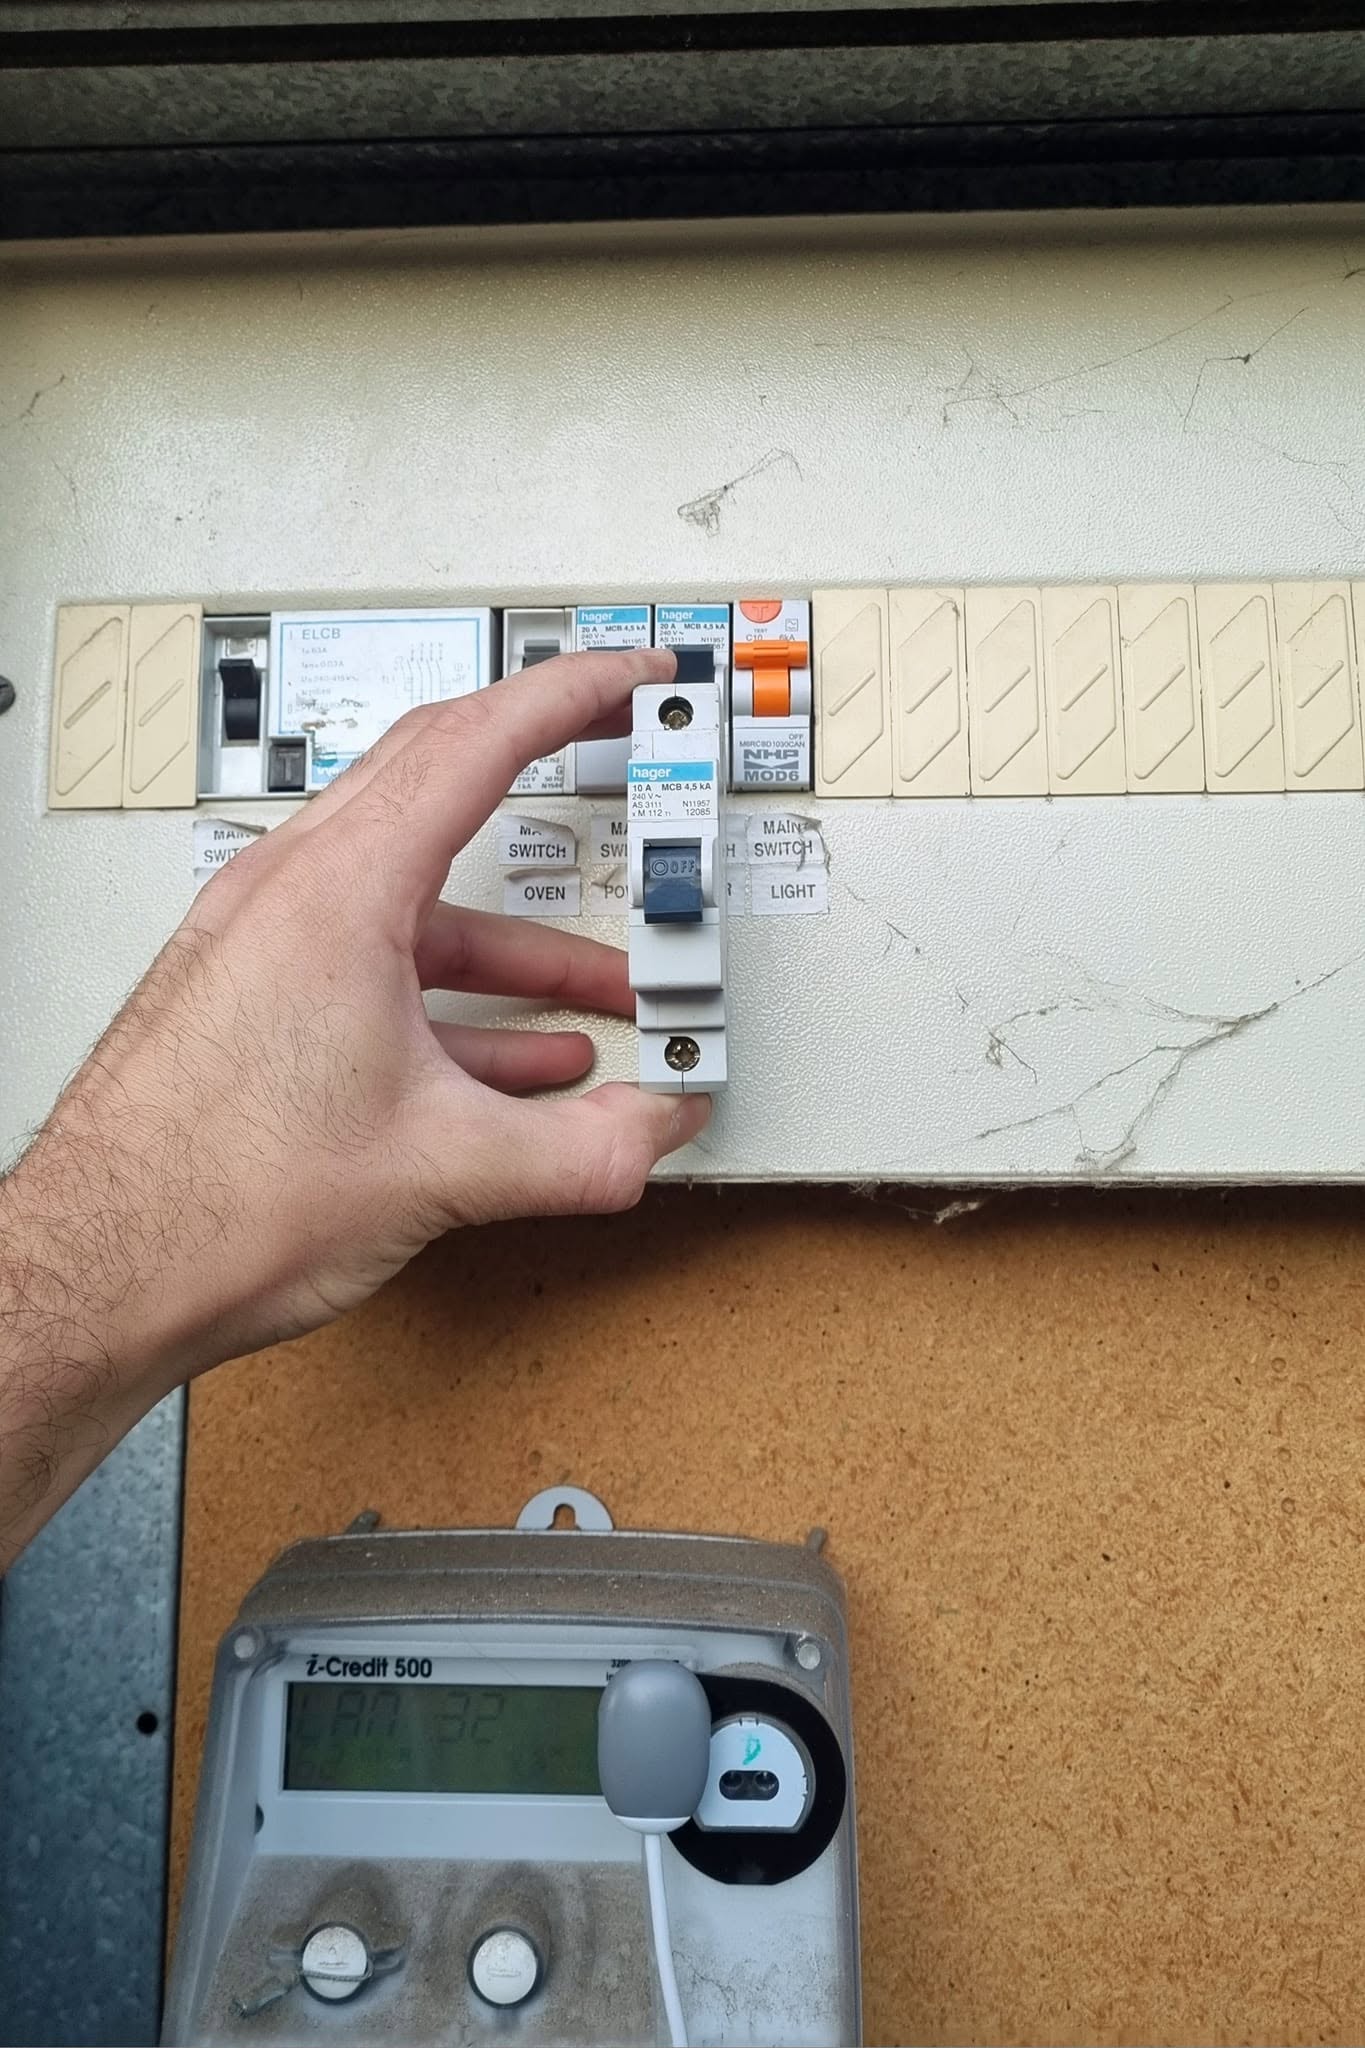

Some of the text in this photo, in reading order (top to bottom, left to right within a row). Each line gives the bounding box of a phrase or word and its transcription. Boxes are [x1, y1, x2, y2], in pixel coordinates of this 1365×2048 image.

[581, 611, 613, 623] hager
[661, 609, 694, 621] hager
[625, 624, 635, 633] 4,5
[637, 624, 646, 632] kA
[703, 623, 714, 631] 4,5
[302, 628, 341, 640] ELCB
[746, 634, 763, 642] C10
[743, 749, 799, 760] NHP
[632, 766, 672, 781] hager
[744, 770, 799, 782] MOD6
[633, 782, 712, 792] 10 A MCB 4,5 kA
[632, 793, 646, 801] 240
[682, 800, 711, 808] N11957
[637, 809, 646, 817] M
[648, 809, 663, 817] 112
[686, 808, 711, 817] 12085
[508, 843, 567, 859] SWITCH
[754, 840, 813, 857] SWITCH
[669, 860, 696, 874] OFF
[524, 886, 566, 901] OVEN
[771, 884, 816, 900] LIGHT
[306, 1654, 433, 1679] i-Credit 500
